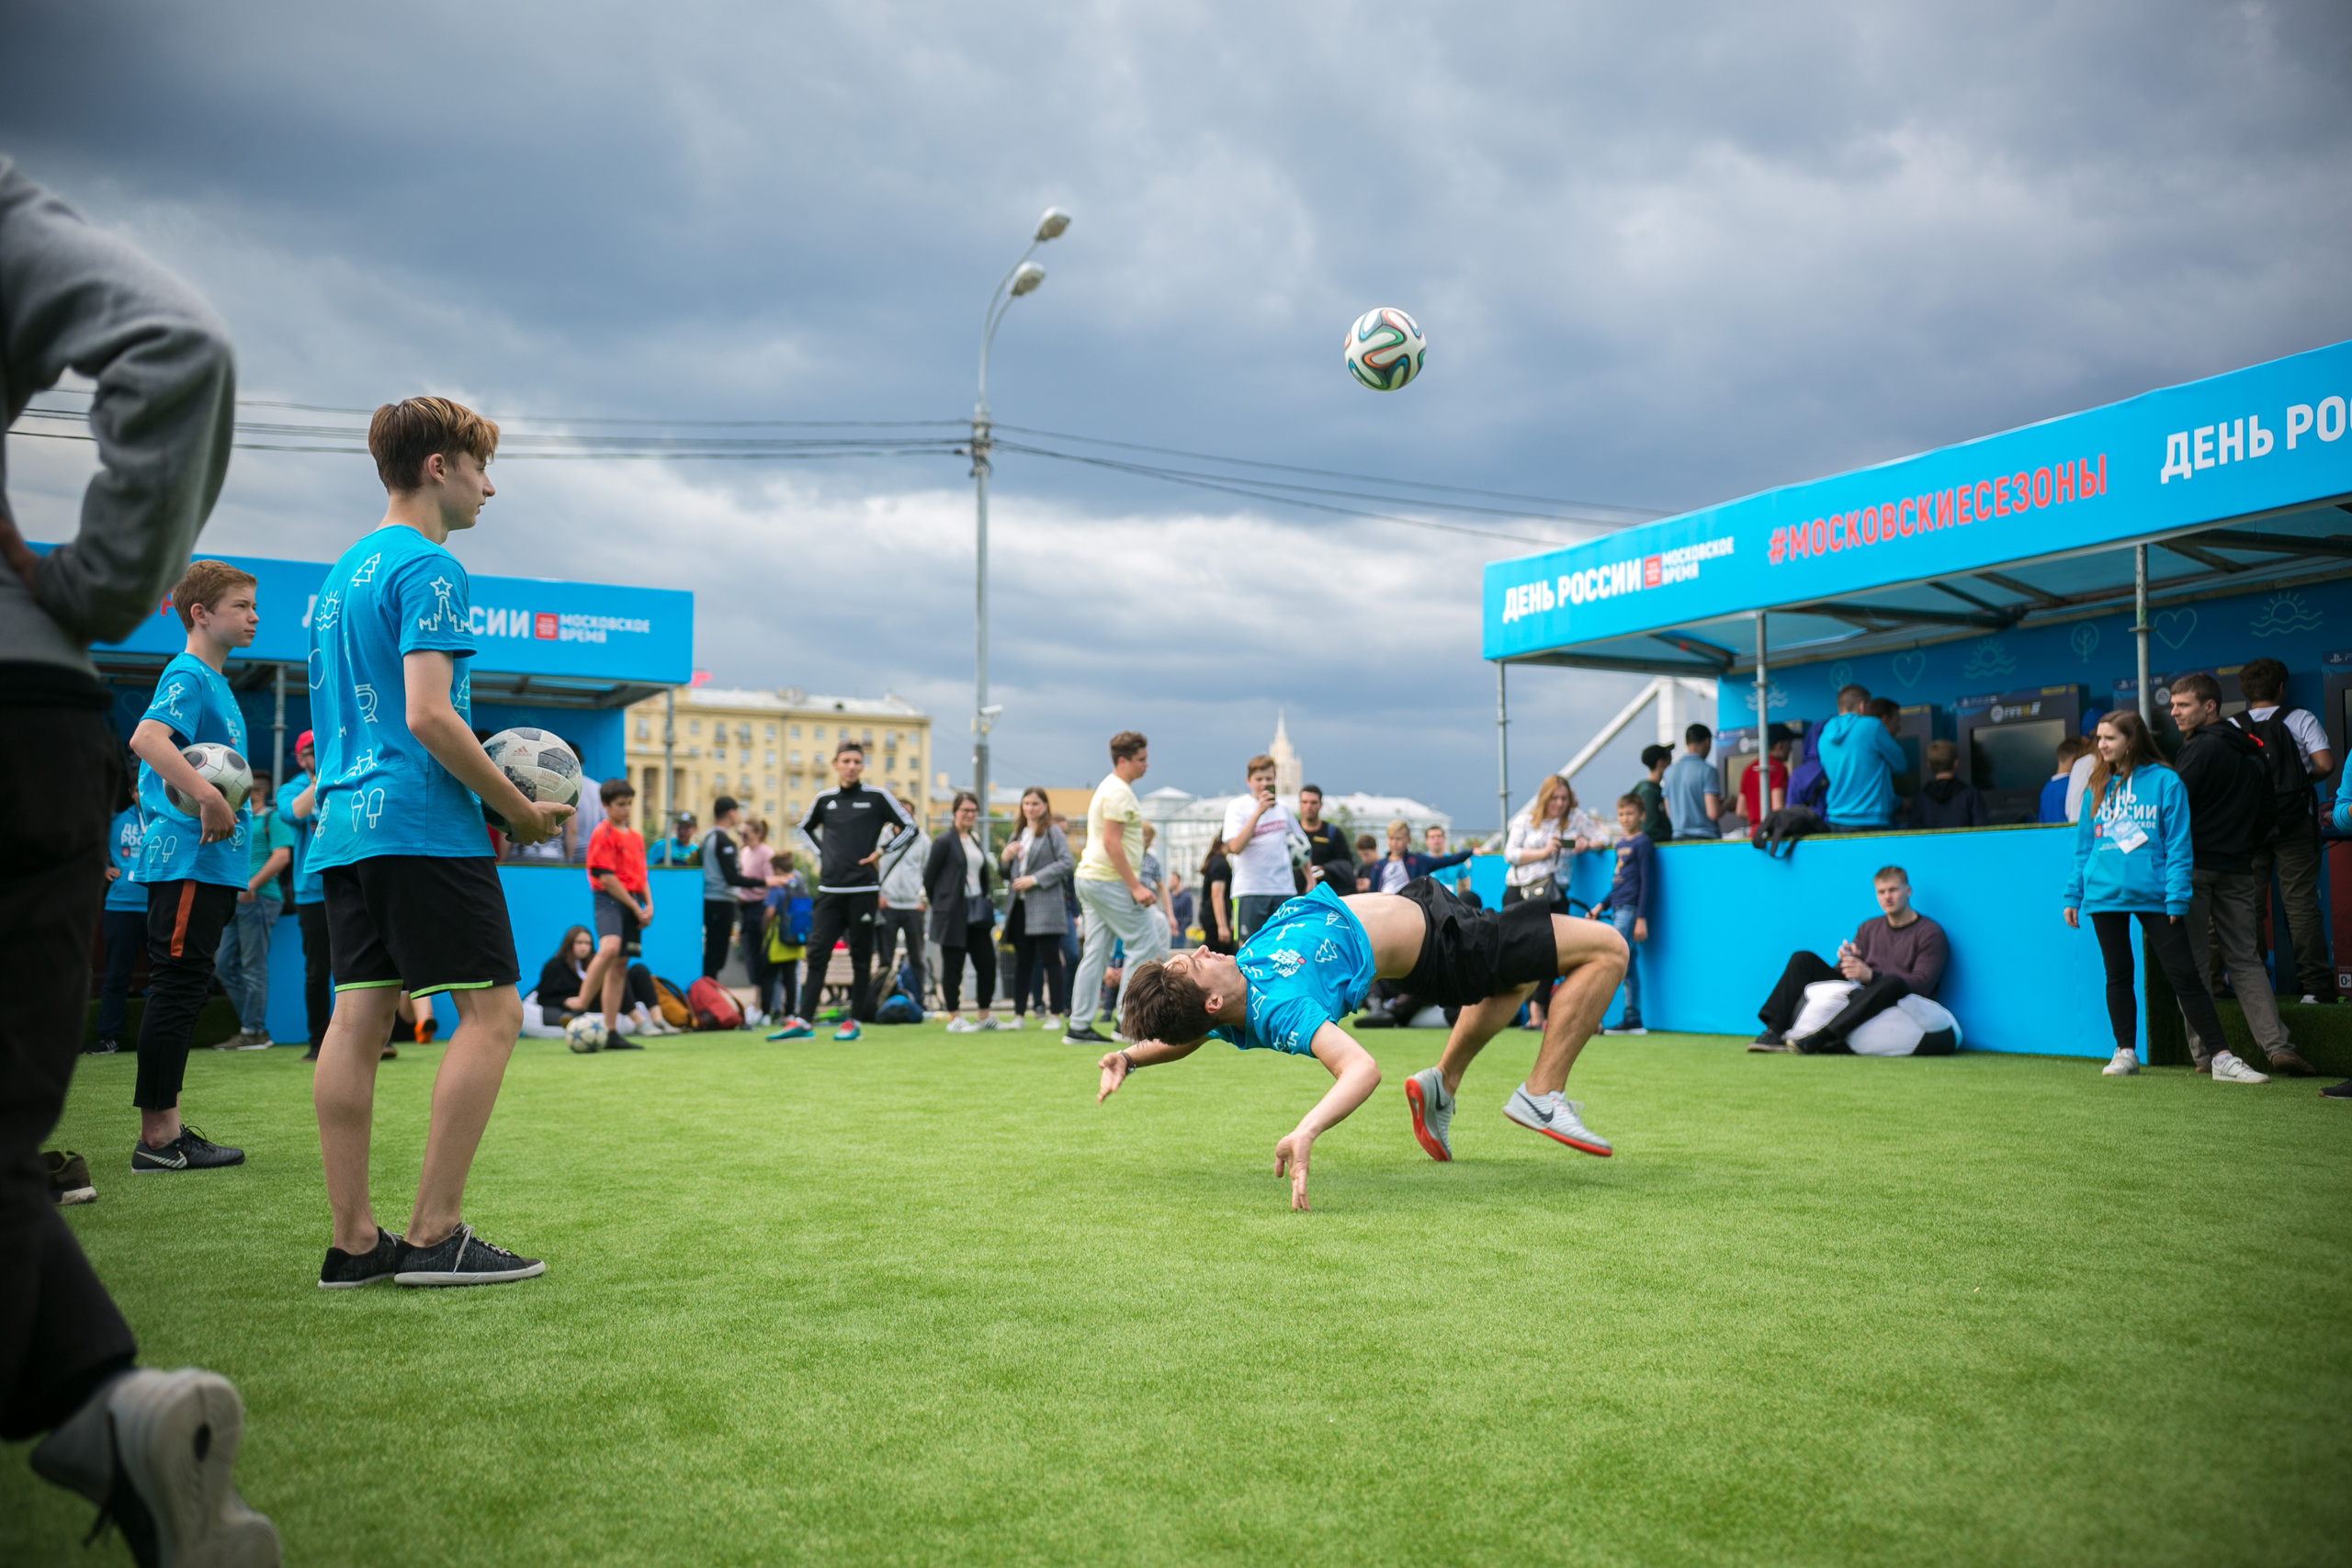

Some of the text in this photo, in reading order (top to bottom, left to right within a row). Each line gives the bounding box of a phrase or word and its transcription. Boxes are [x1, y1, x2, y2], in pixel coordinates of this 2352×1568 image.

[2160, 395, 2352, 485] ДЕНЬ РО
[1768, 454, 2107, 566] #МОСКОВСКИЕСЕЗОНЫ
[1661, 536, 1736, 566] МОСКОВСКОЕ
[1661, 562, 1700, 586] ВРЕМЯ
[1502, 580, 1555, 625] ДЕНЬ
[1557, 558, 1643, 608] РОССИИ
[469, 605, 530, 639] СИИ
[560, 614, 650, 634] МОСКОВСКОЕ
[560, 627, 607, 644] ВРЕМЯ
